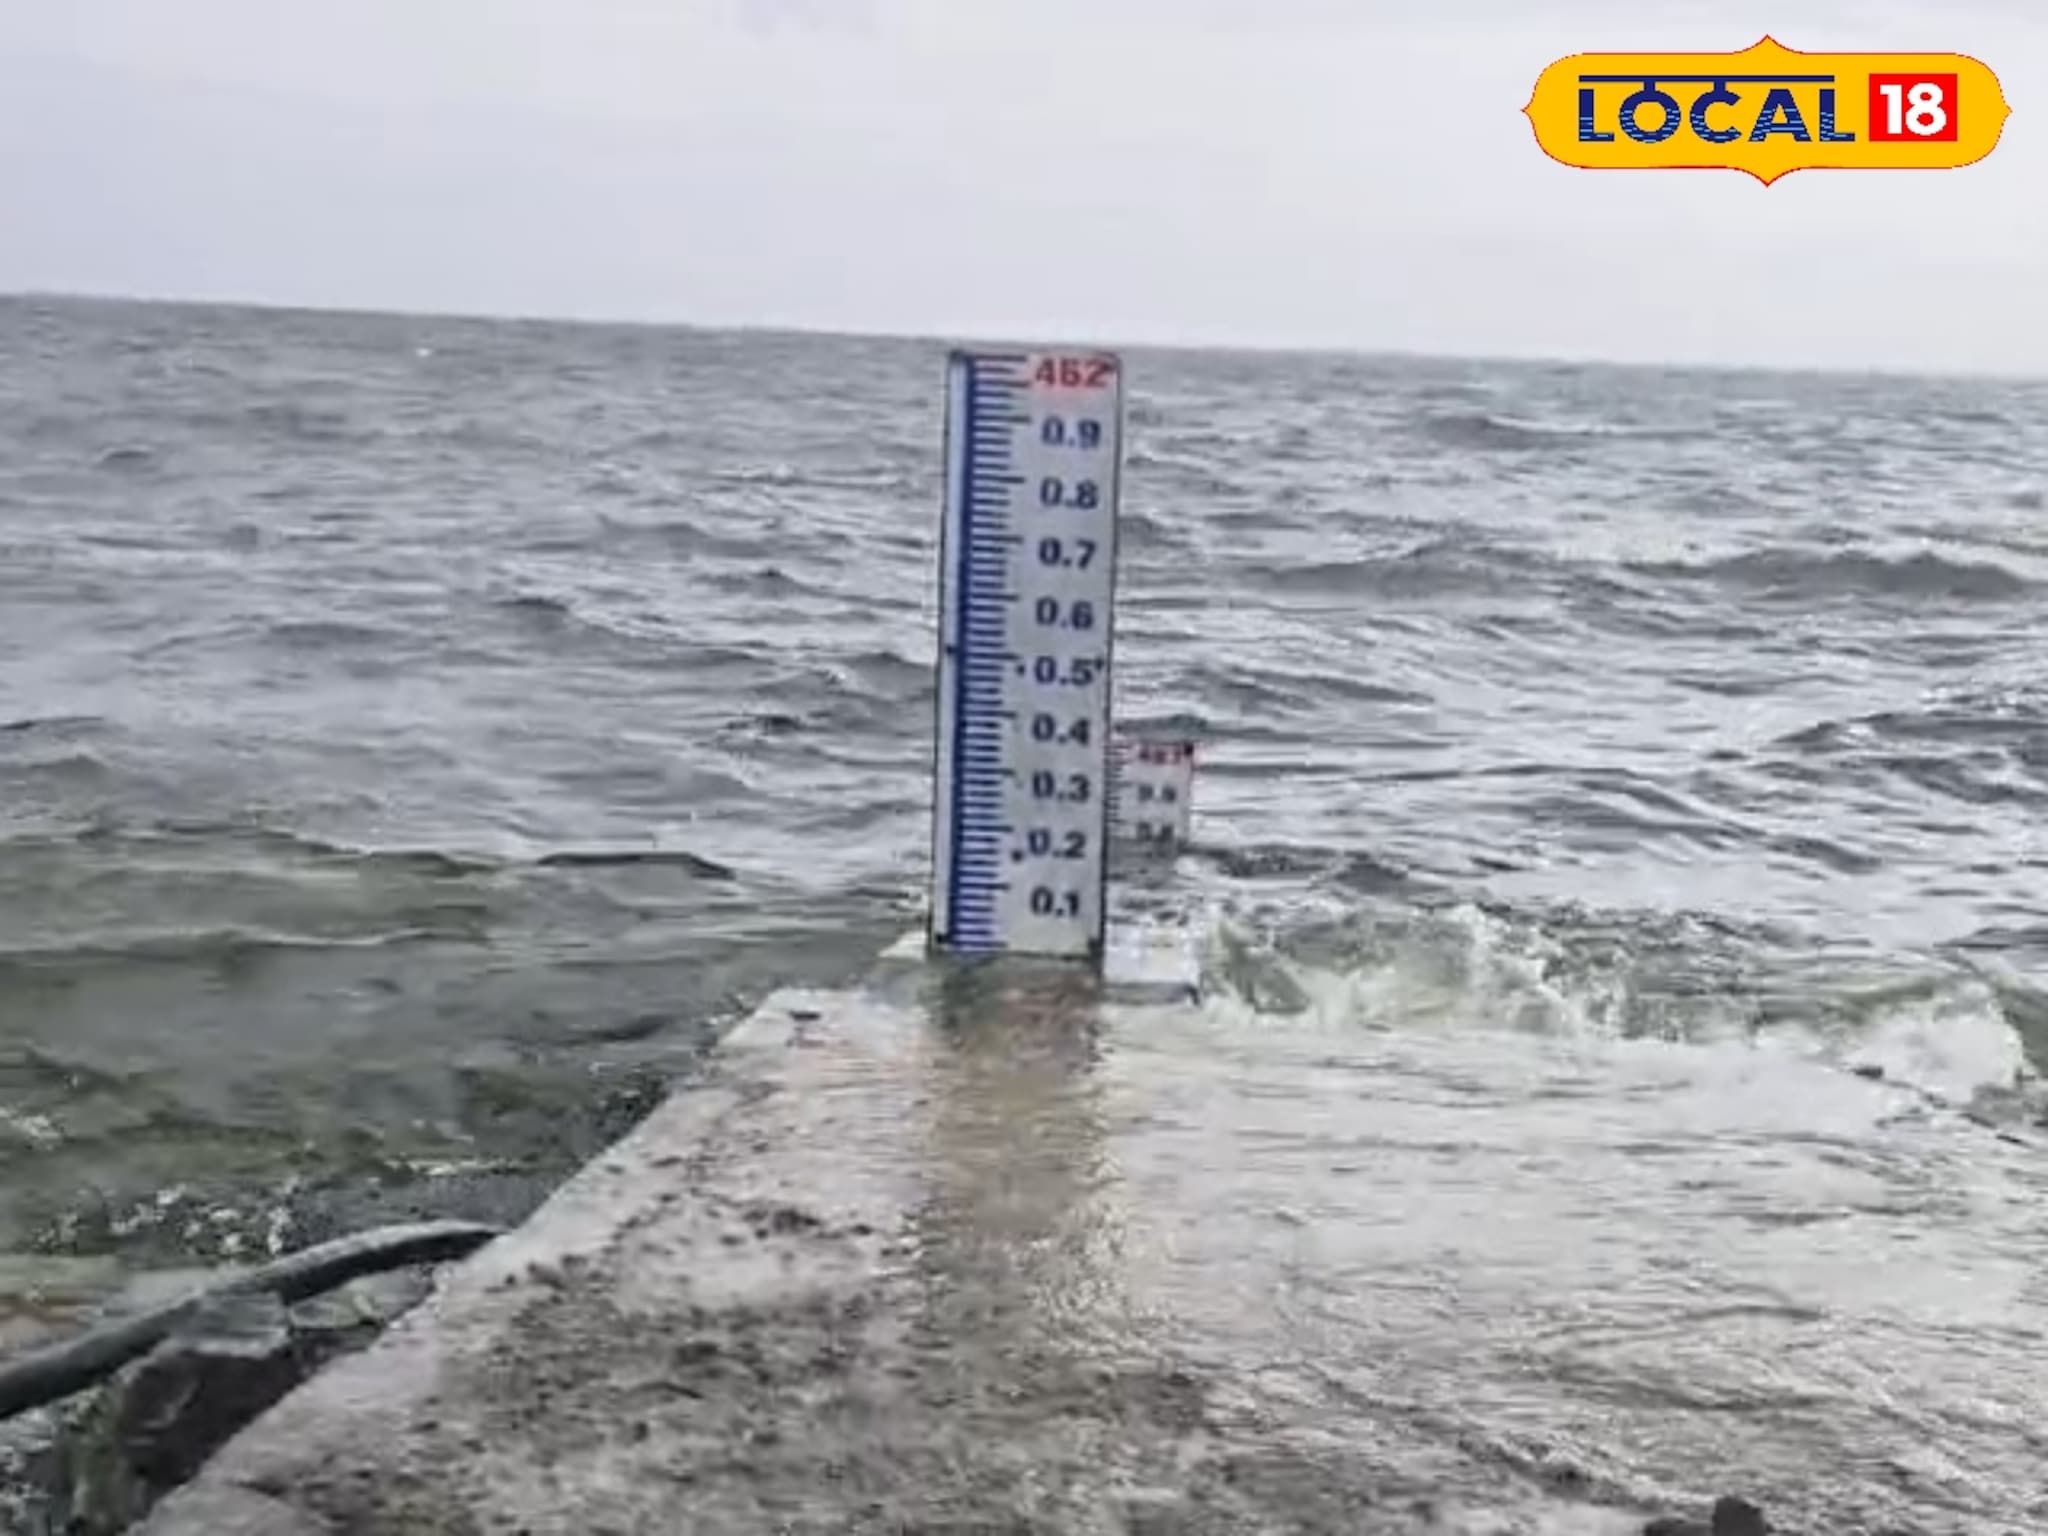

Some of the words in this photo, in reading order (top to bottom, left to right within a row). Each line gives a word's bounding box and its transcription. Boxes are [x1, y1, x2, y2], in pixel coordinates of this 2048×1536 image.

[1035, 357, 1110, 387] 462
[1041, 416, 1101, 449] 0.9
[1040, 477, 1099, 509] 0.8
[1039, 537, 1097, 570] 0.7
[1035, 597, 1094, 630] 0.6
[1035, 656, 1094, 686] 0.5
[1033, 714, 1089, 744] 0.4
[1033, 771, 1090, 802] 0.3
[1029, 831, 1086, 859] 0.2
[1031, 887, 1080, 917] 0.1
